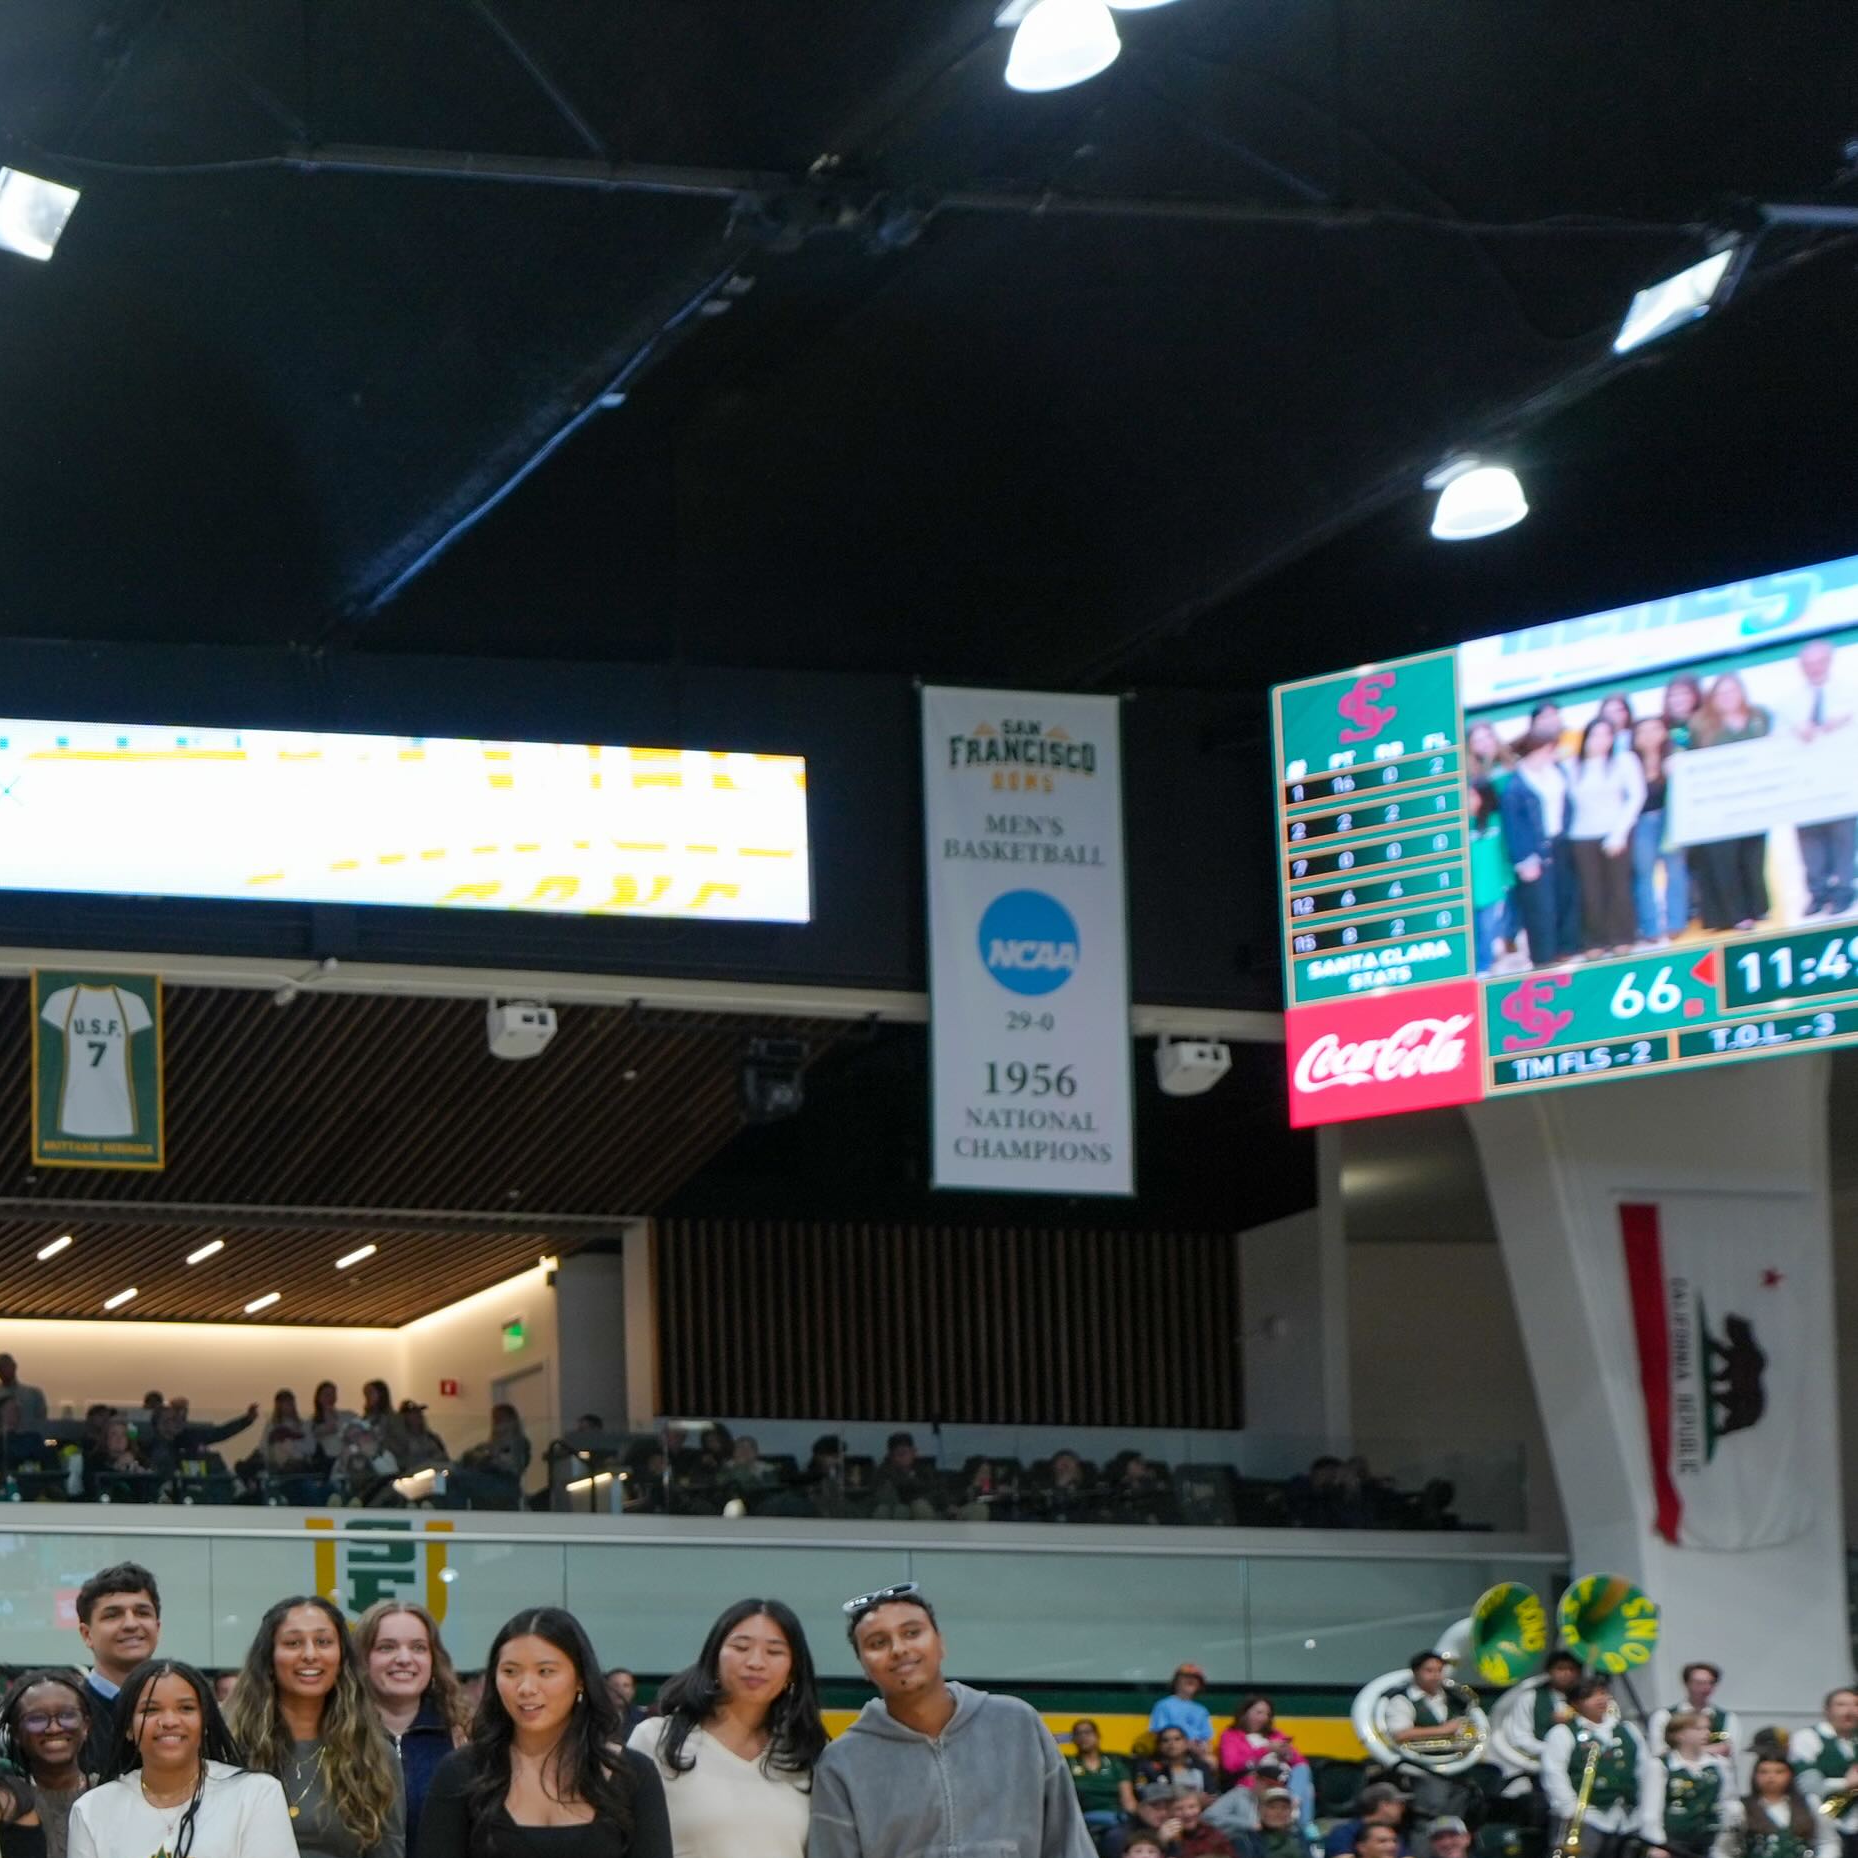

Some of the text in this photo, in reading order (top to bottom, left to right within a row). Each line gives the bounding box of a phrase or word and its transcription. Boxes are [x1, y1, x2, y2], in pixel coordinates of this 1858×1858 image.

[1001, 719, 1041, 736] SAN
[948, 735, 1097, 774] FRANCISCO
[984, 814, 1065, 836] MEN'S
[1291, 822, 1306, 840] 2
[1337, 813, 1352, 831] 2
[1385, 804, 1400, 822] 2
[944, 837, 1106, 867] BASKETBALL
[988, 939, 1077, 971] NCAA
[1307, 939, 1452, 981] SANTA CLARA
[1348, 965, 1412, 990] STATS
[1610, 967, 1683, 1019] 66
[73, 1017, 121, 1038] U.S.F.
[1005, 1011, 1055, 1032] 29-0
[1816, 1013, 1836, 1037] 3
[87, 1042, 107, 1067] 7
[1512, 1057, 1555, 1081] TM
[1558, 1047, 1612, 1076] FLS
[1632, 1041, 1652, 1064] 2
[984, 1060, 1078, 1099] 1956
[965, 1106, 1098, 1131] NATIONAL
[953, 1135, 1113, 1164] CHAMPIONS
